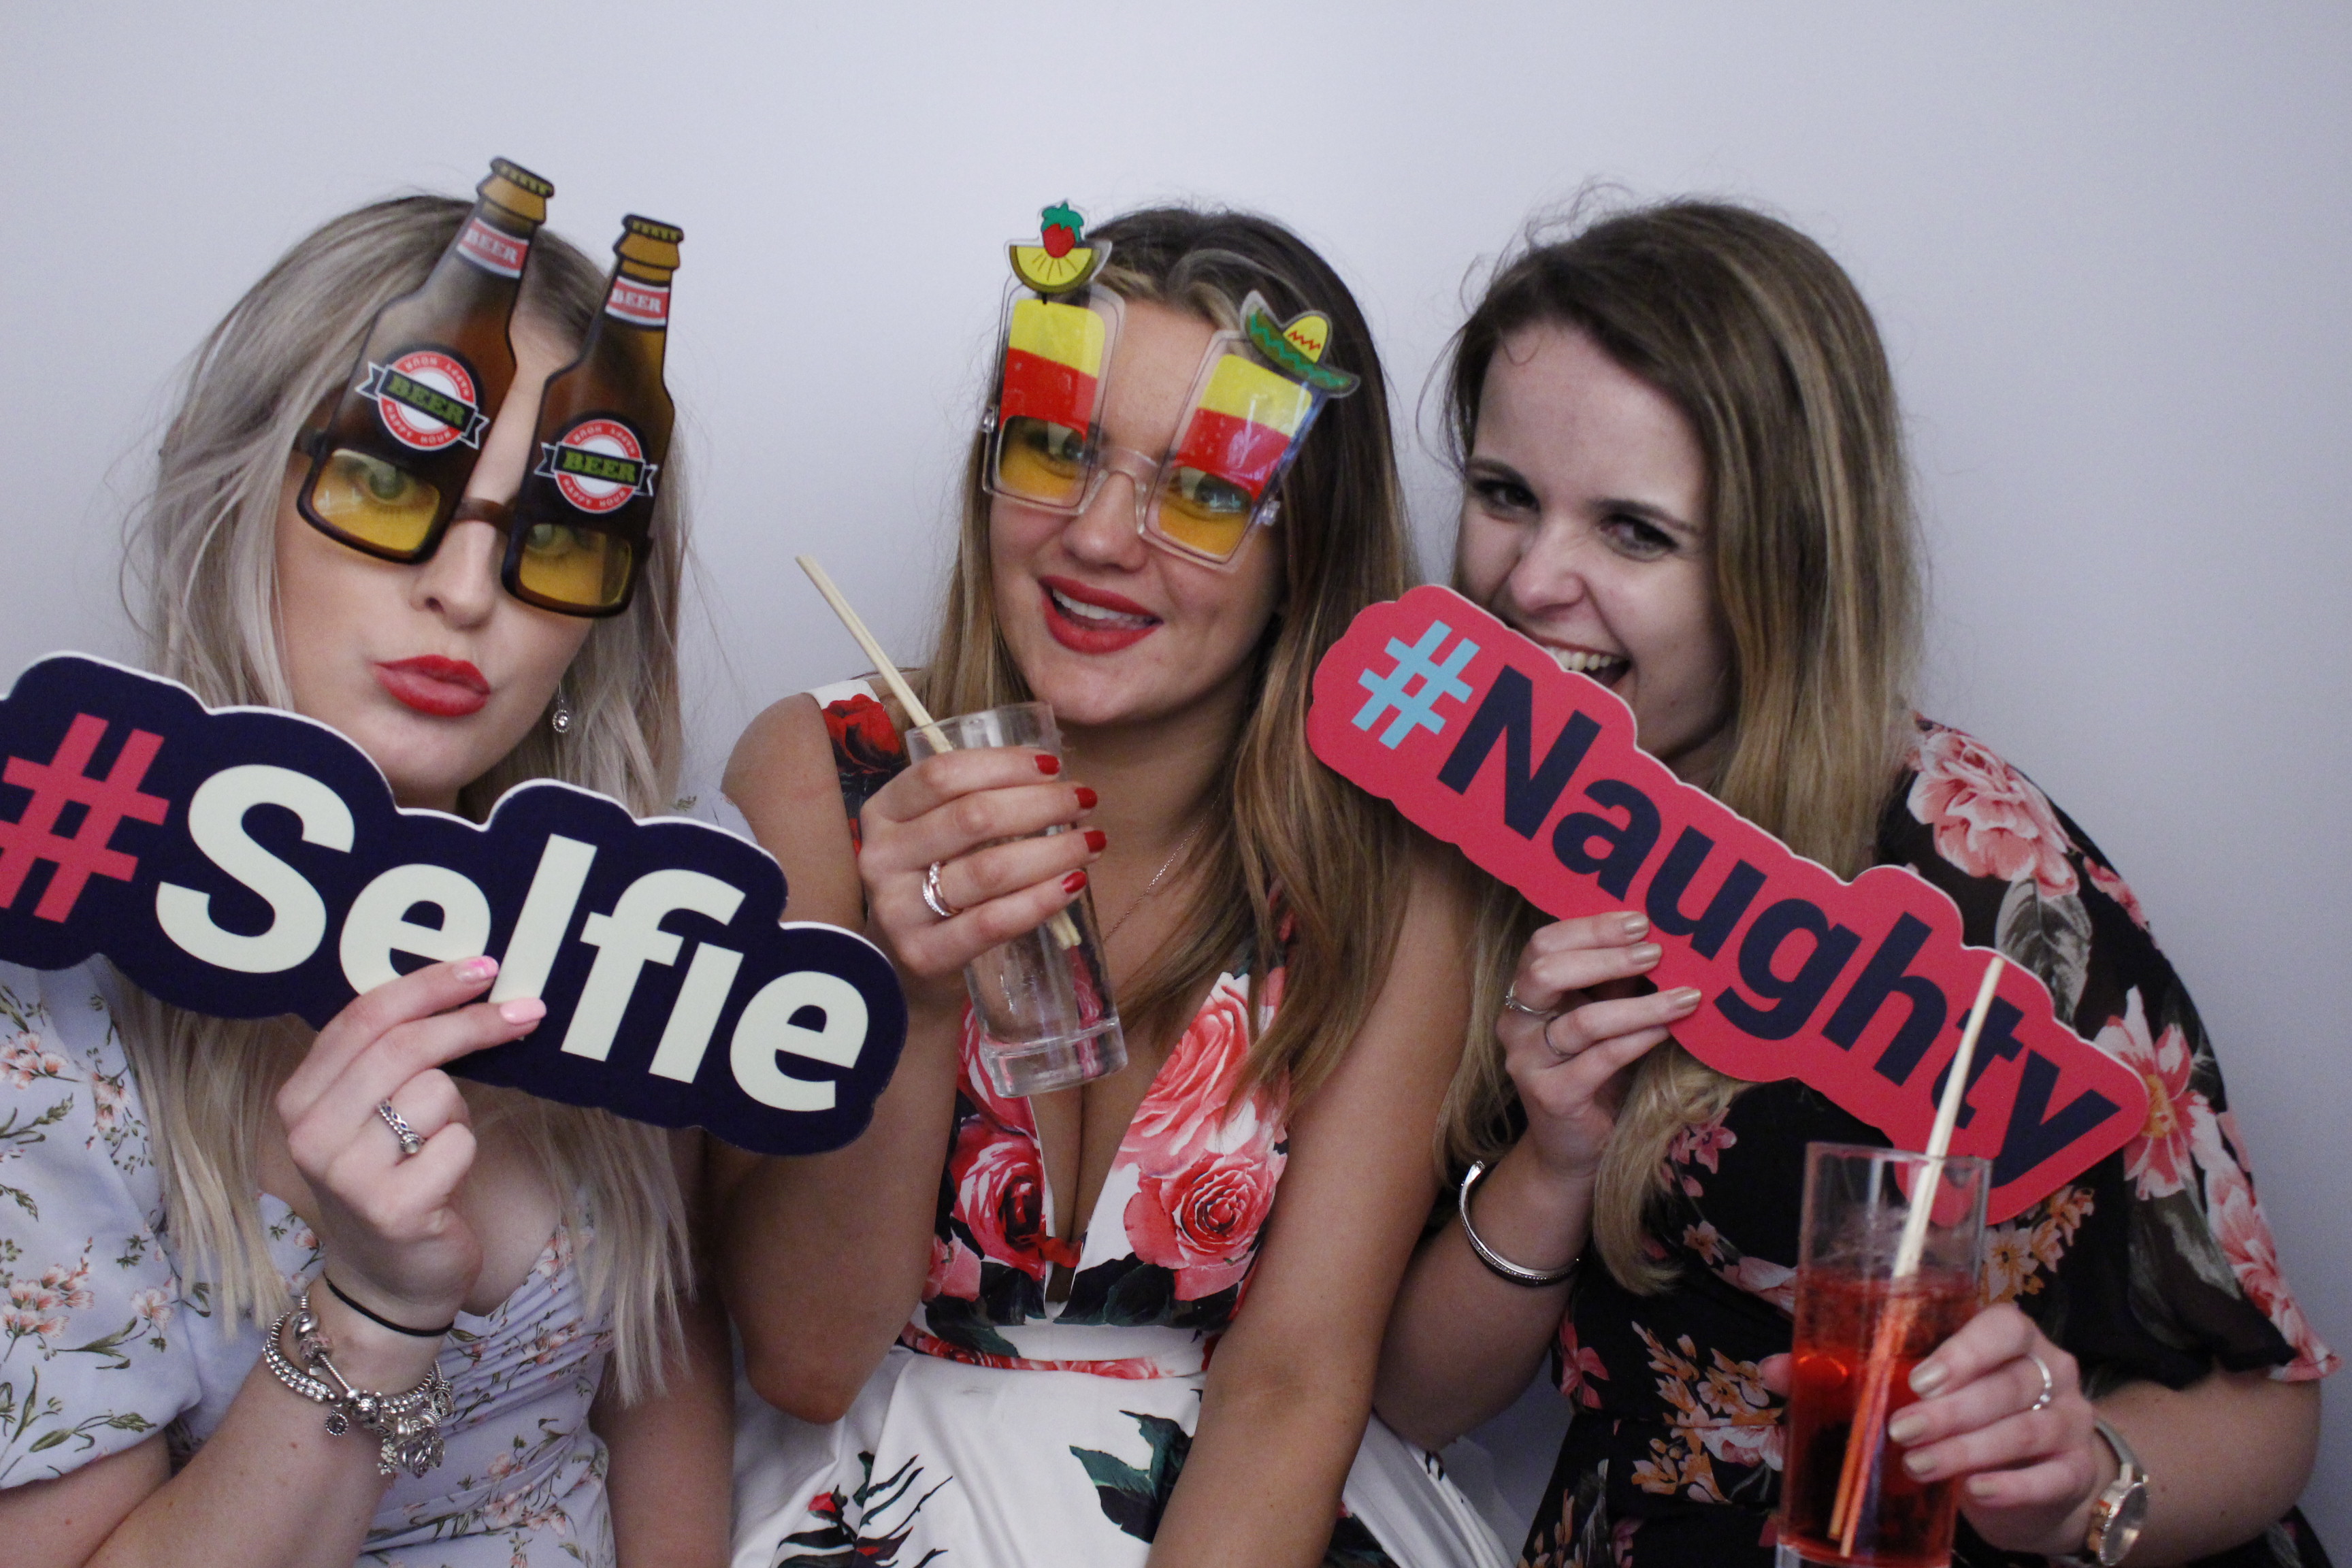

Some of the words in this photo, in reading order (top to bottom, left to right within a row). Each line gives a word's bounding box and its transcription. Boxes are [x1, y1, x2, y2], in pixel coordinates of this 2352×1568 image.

[464, 228, 518, 264] BEER
[611, 288, 662, 314] BEER
[405, 357, 438, 370] HOUR
[387, 374, 466, 426] BEER
[386, 404, 413, 437] HAPPY
[420, 431, 452, 443] HOUR
[574, 426, 602, 442] HOUR
[563, 450, 636, 483] BEER
[564, 478, 593, 506] HAPPY
[599, 490, 626, 507] HOUR
[0, 712, 869, 1112] #Selfie
[1351, 619, 2120, 1187] #Naughty
